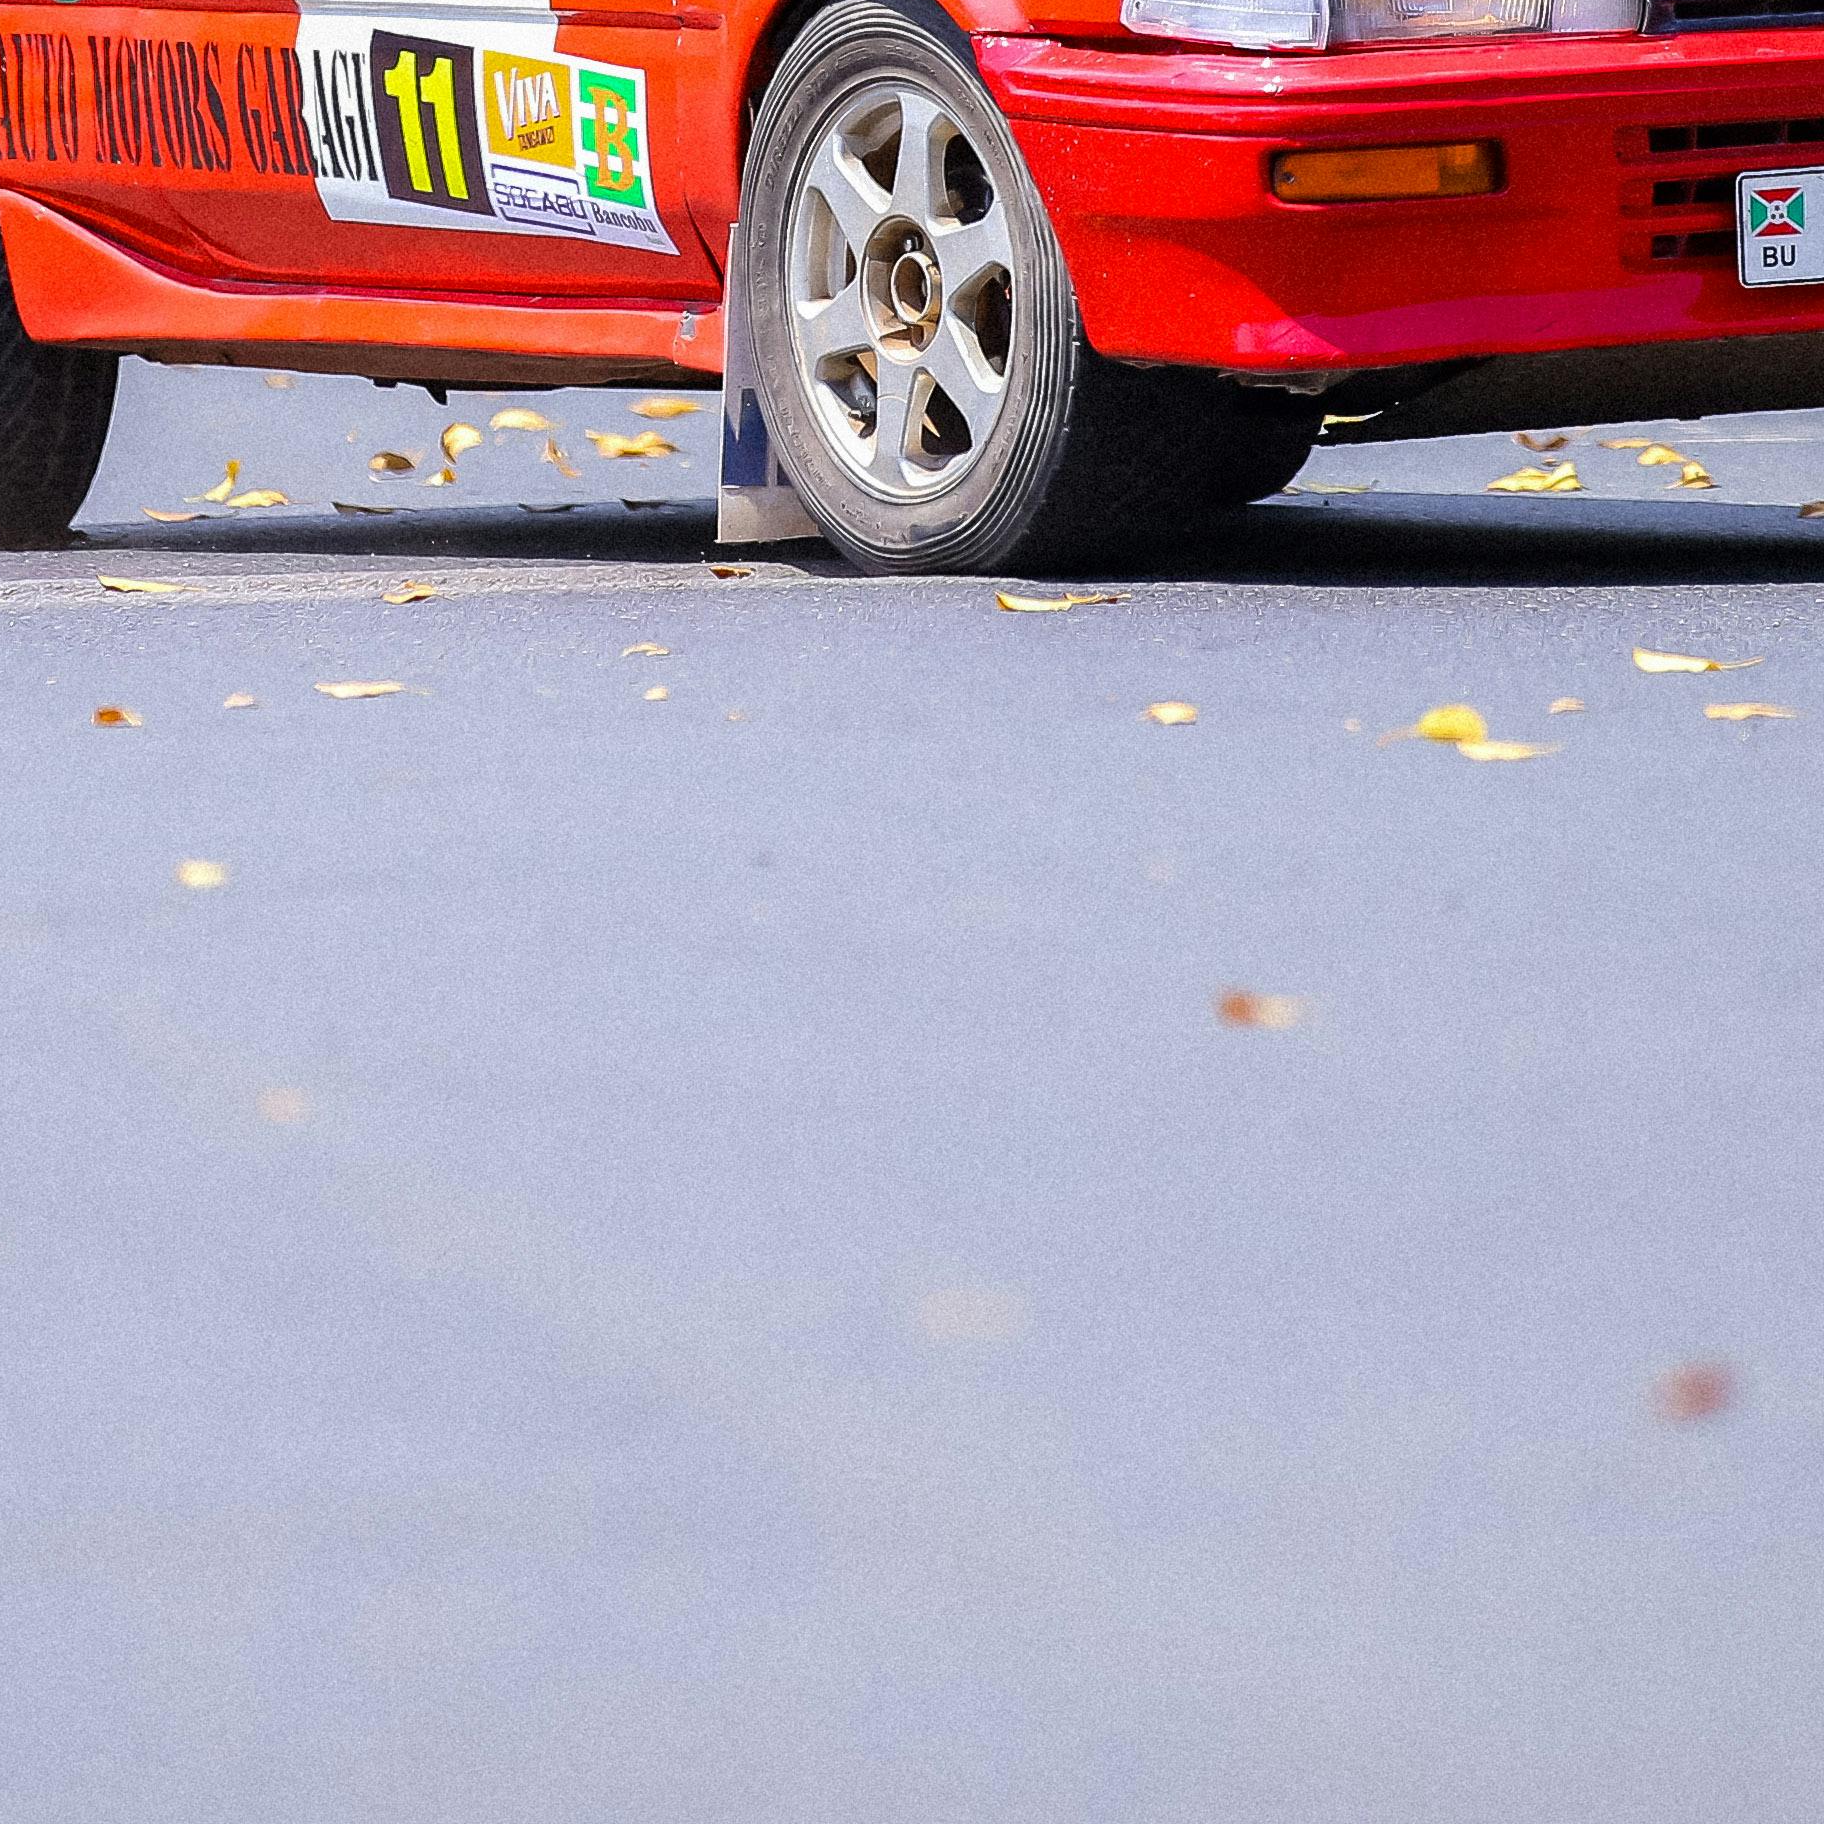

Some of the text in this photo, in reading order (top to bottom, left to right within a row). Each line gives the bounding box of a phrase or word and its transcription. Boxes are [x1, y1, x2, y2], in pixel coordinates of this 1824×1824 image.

[88, 36, 231, 172] MOTORS
[384, 50, 469, 200] 11
[493, 67, 560, 140] VIVA
[494, 182, 588, 220] SOCABU
[590, 201, 658, 234] Bancobu
[1762, 244, 1797, 268] BU
